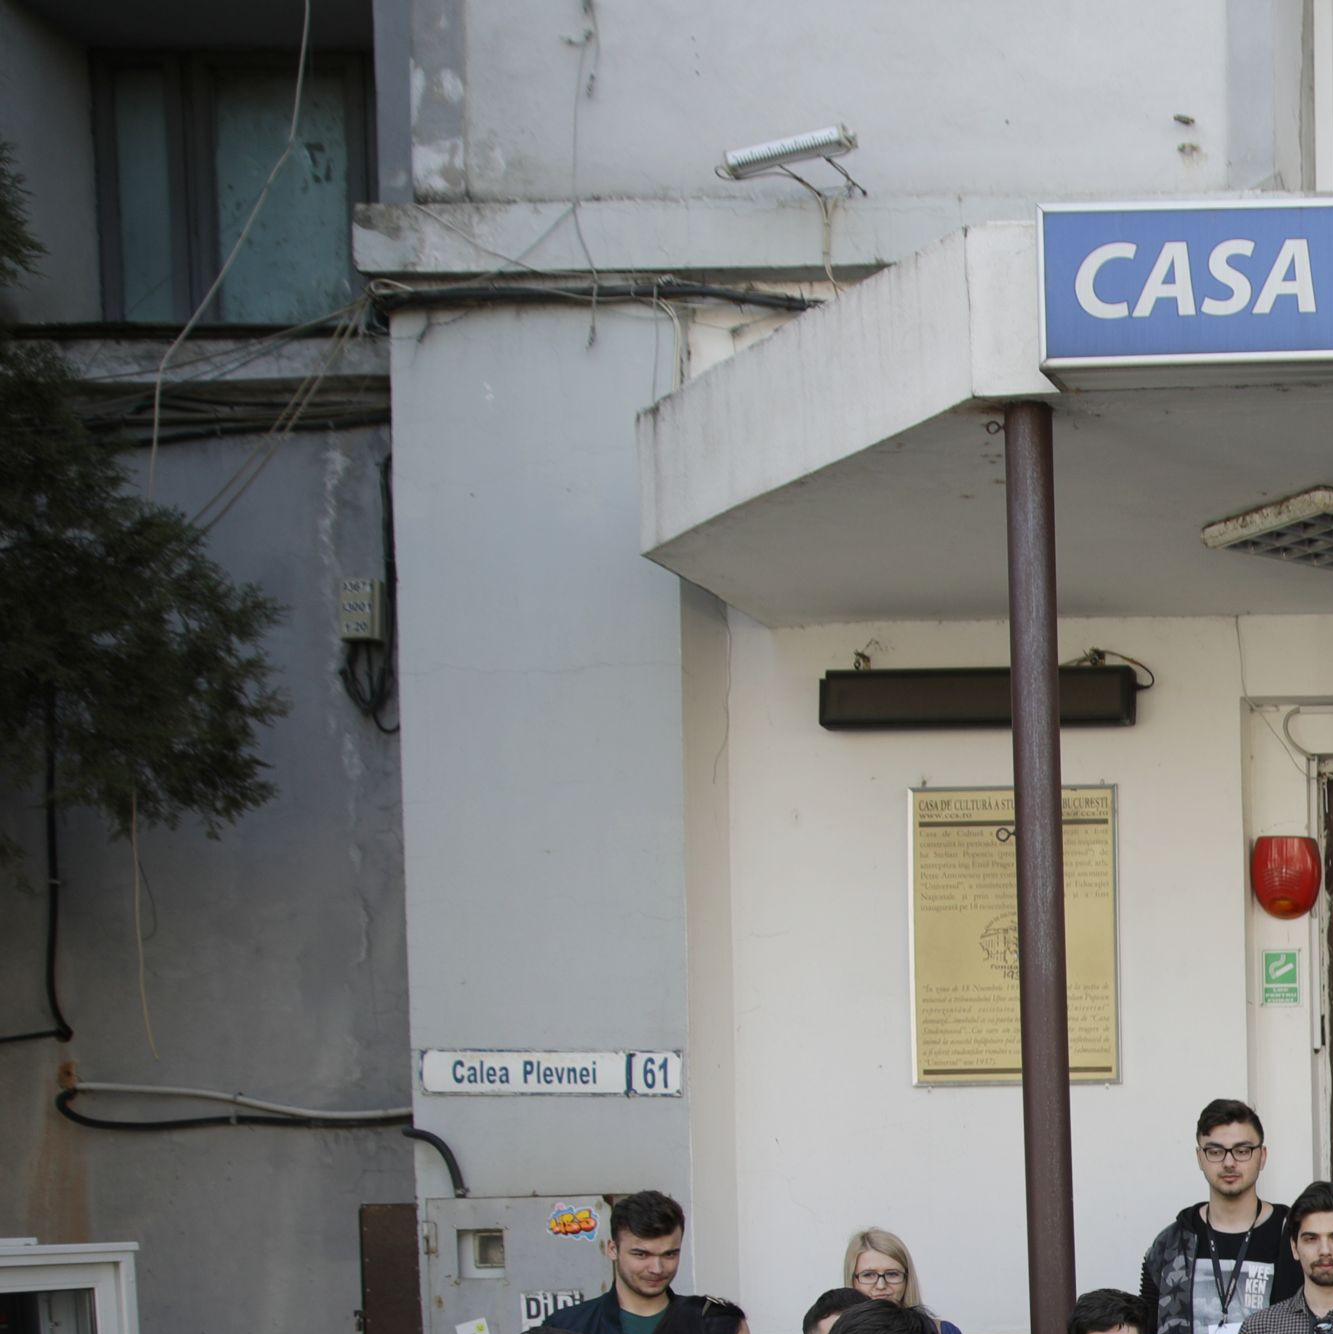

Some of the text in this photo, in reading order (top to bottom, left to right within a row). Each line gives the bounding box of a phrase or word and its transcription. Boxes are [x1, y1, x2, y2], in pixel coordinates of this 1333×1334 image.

[1074, 238, 1318, 319] CASA
[452, 1060, 597, 1084] Calea Plevnei
[642, 1056, 669, 1089] 61
[1248, 1265, 1271, 1280] WEE
[1245, 1279, 1267, 1294] KEN
[1244, 1293, 1264, 1309] DER
